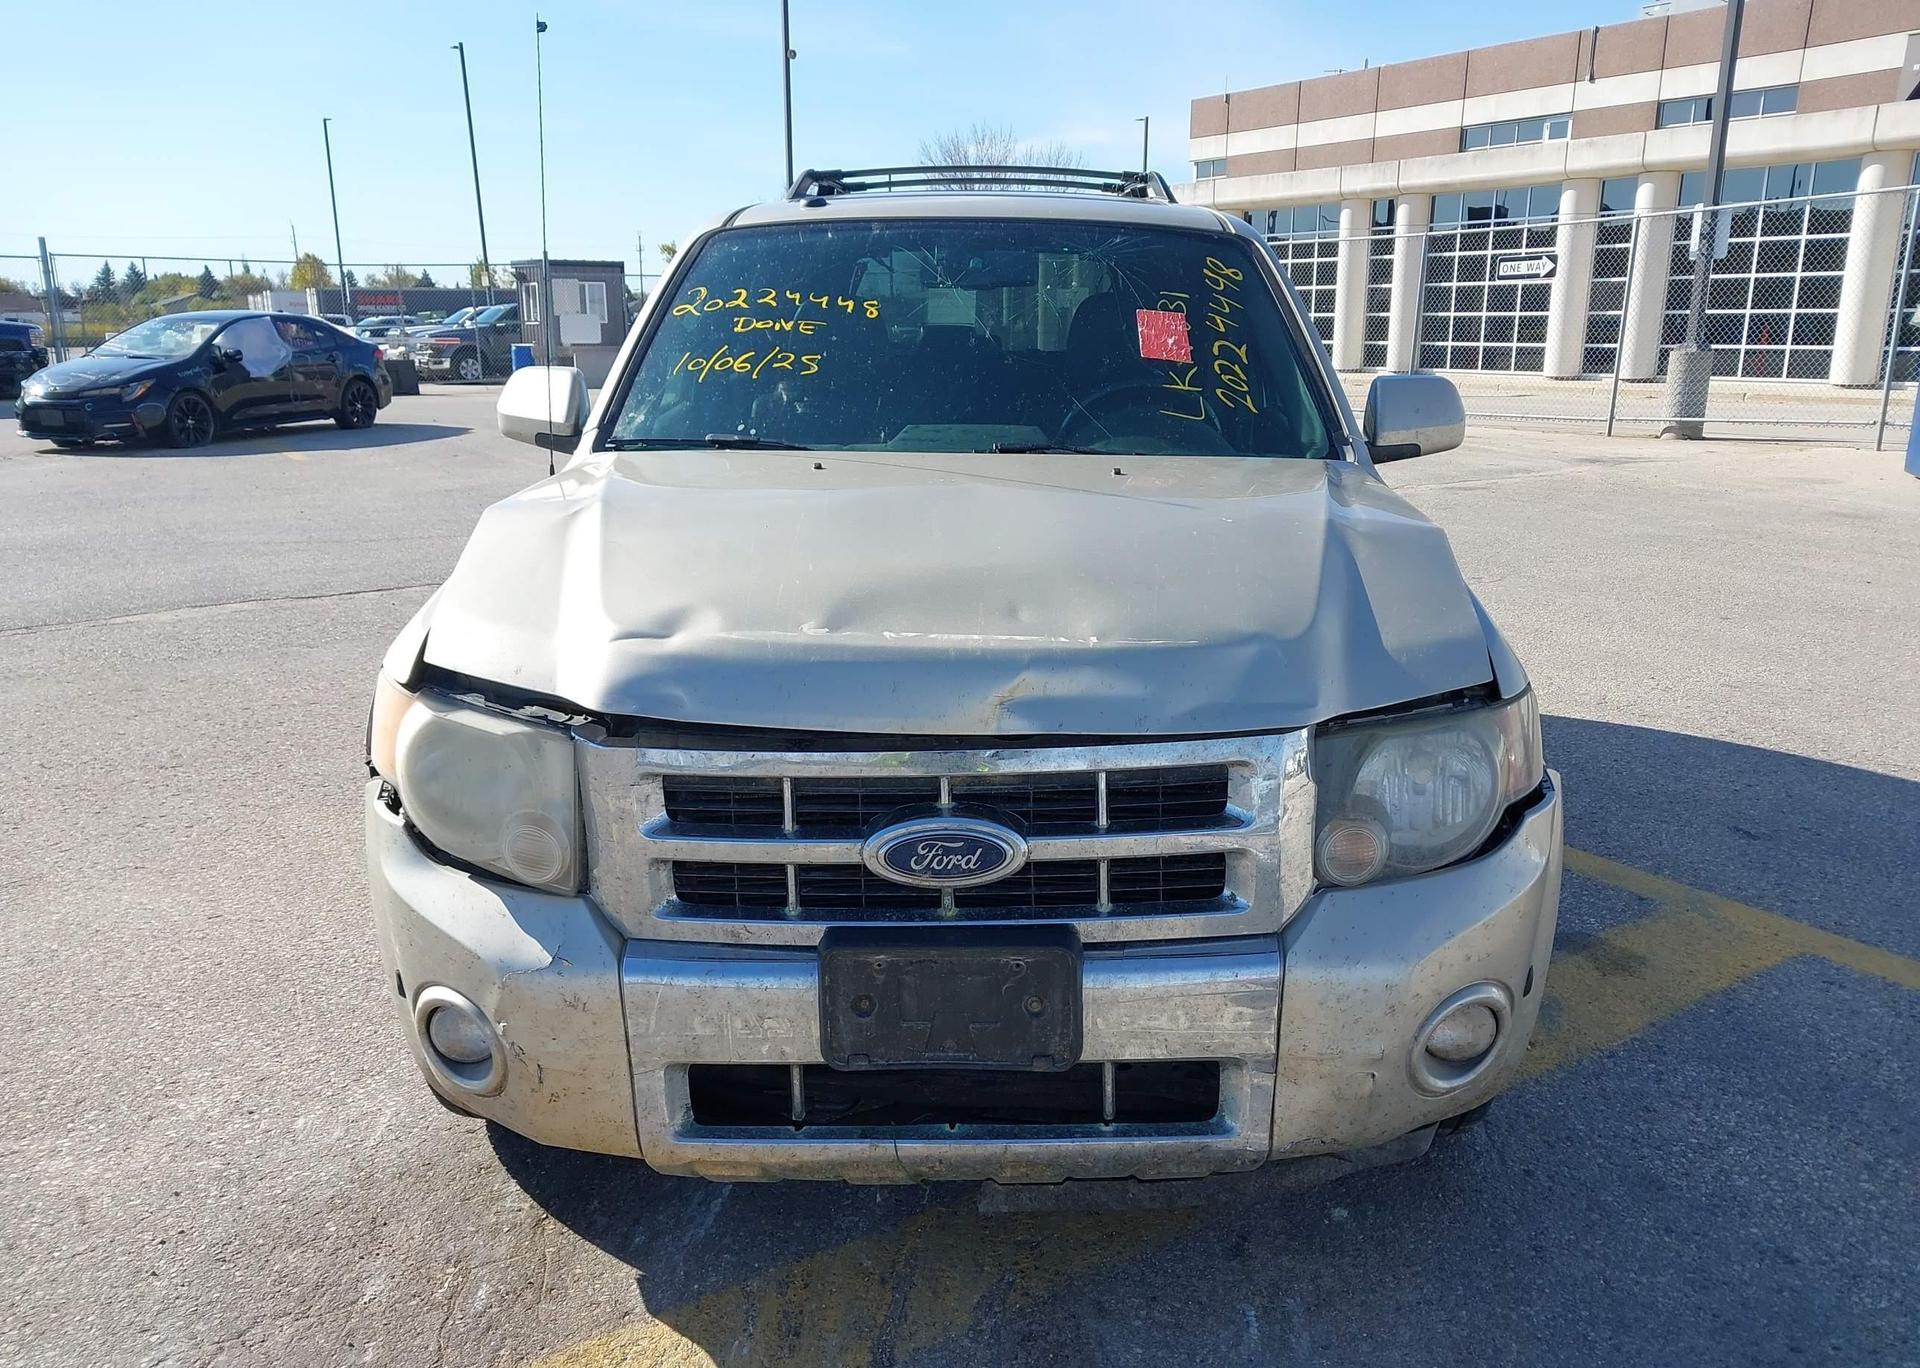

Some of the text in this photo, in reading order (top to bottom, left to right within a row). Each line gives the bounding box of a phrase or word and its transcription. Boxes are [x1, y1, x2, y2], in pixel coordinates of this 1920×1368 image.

[1502, 261, 1547, 274] ONE WAY
[672, 286, 880, 319] 20224448
[673, 345, 822, 384] 10/06/25
[910, 840, 983, 870] Ford
